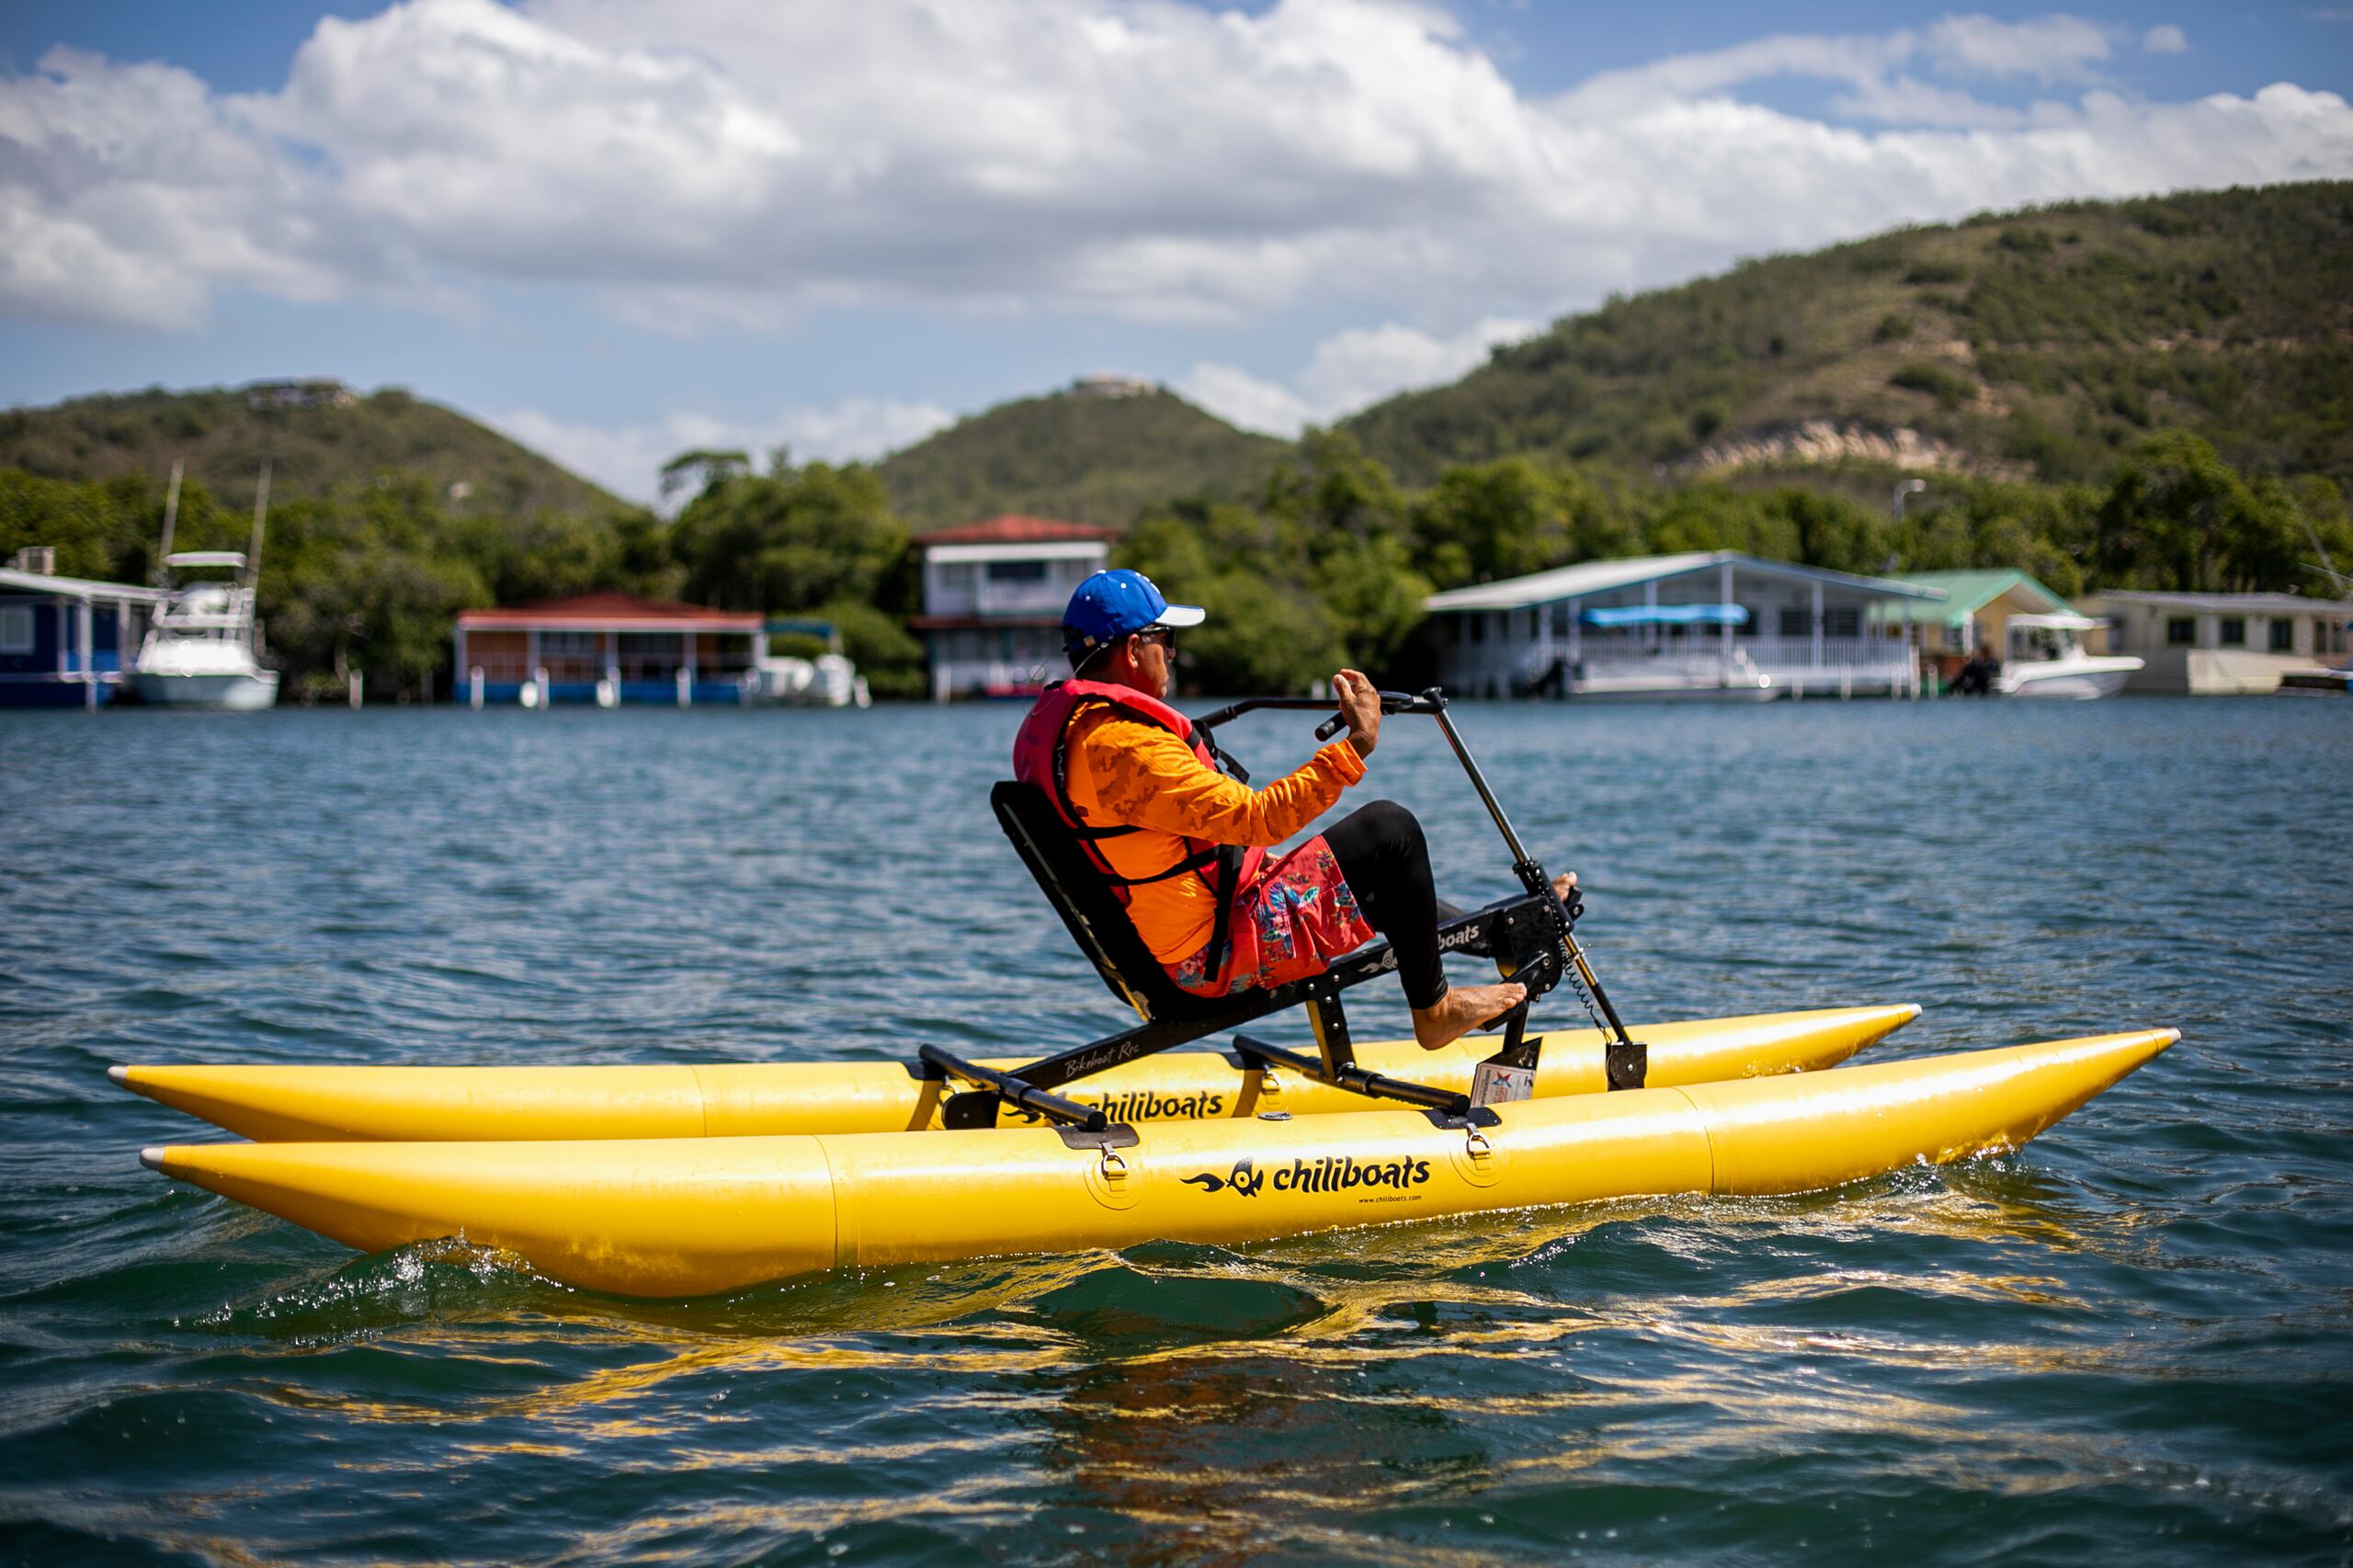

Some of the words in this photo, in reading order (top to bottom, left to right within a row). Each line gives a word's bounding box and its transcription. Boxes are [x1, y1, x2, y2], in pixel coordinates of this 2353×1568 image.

[1064, 1047, 1115, 1078] Bikeboat
[1273, 1155, 1430, 1193] chiliboats
[1358, 1195, 1422, 1204] www.chiliboats.com
